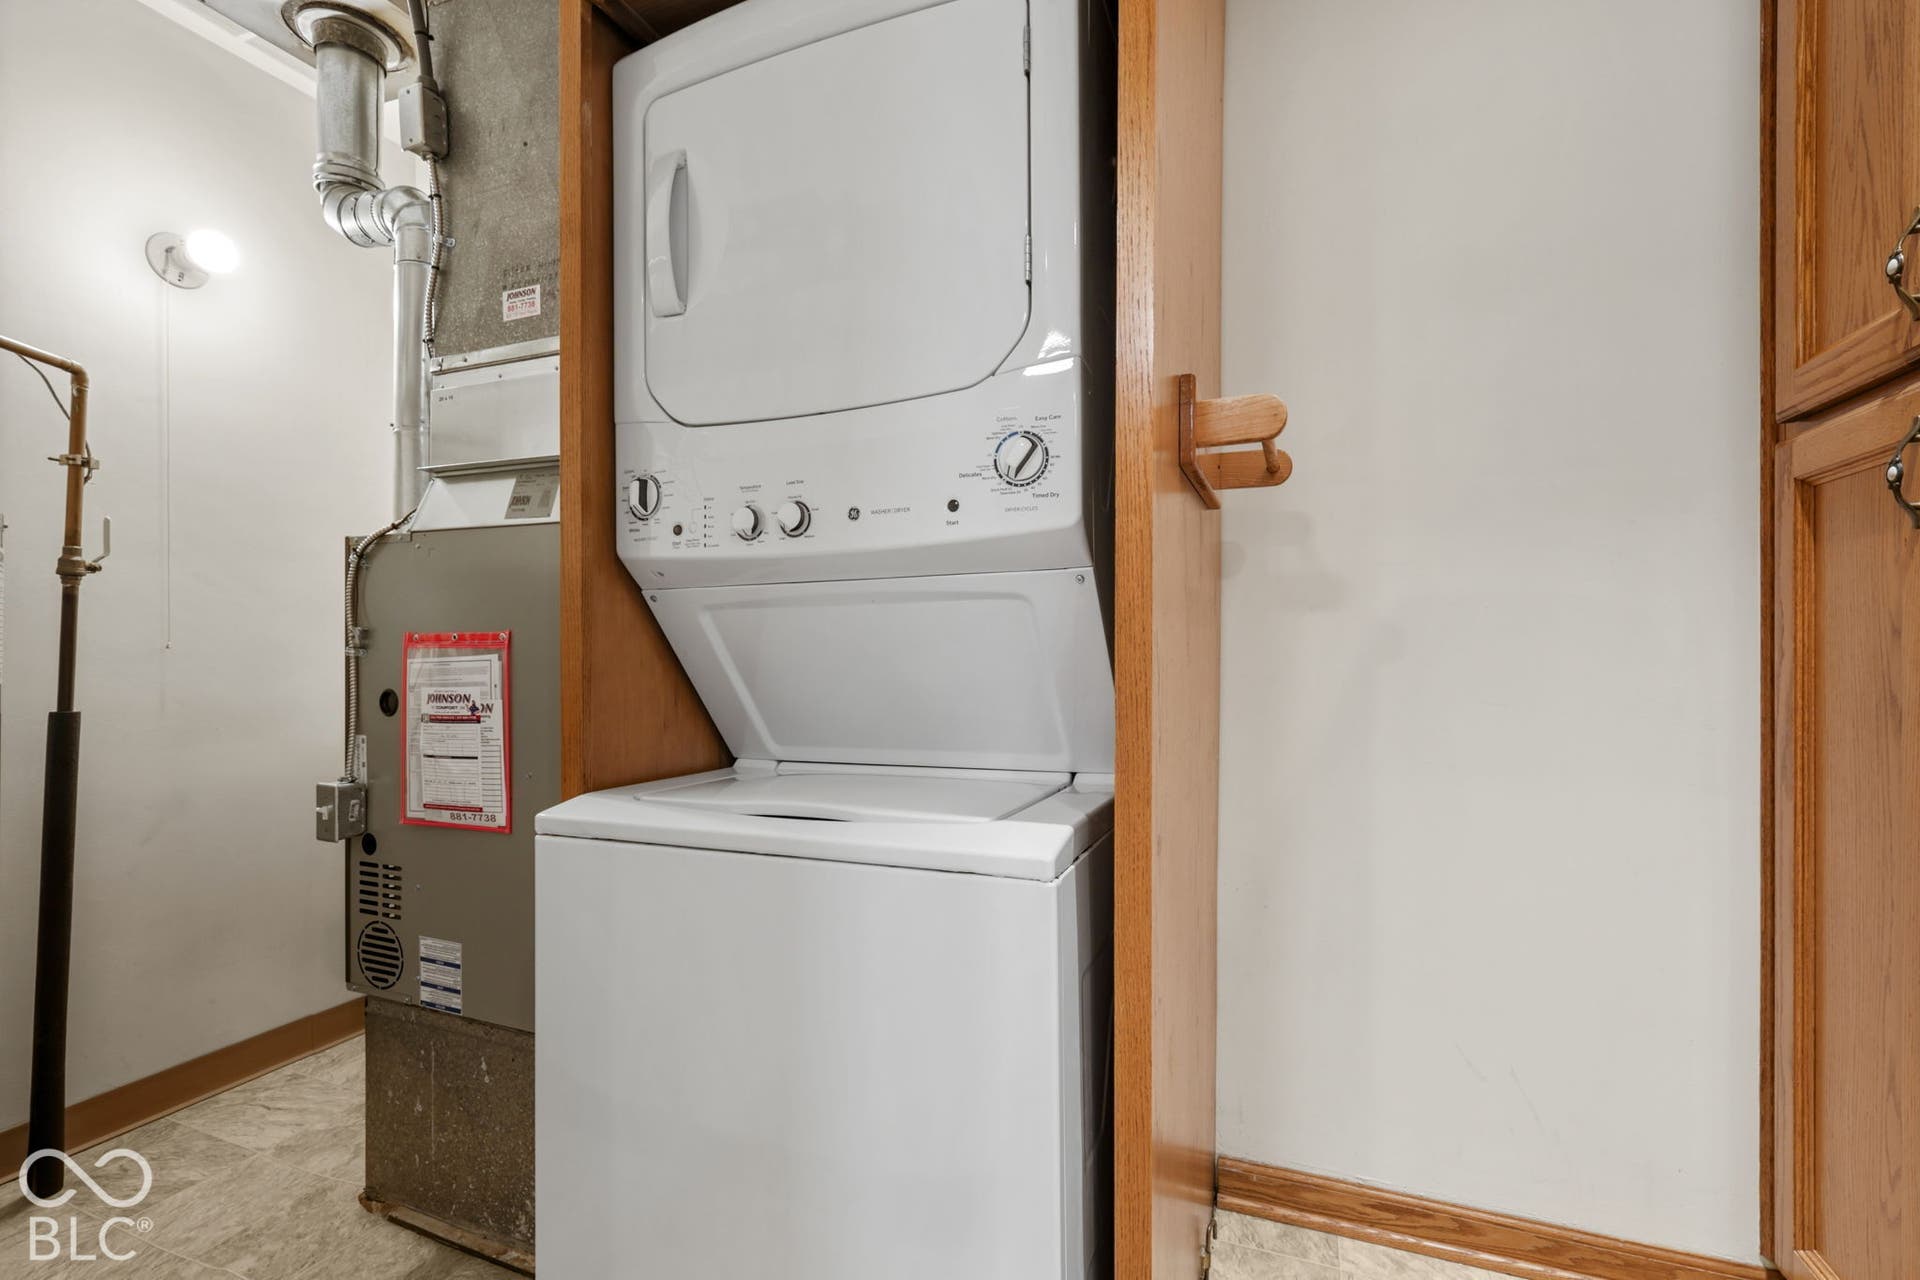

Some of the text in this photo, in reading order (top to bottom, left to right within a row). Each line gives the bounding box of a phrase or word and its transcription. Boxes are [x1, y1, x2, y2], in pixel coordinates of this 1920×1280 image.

[507, 287, 536, 302] JOHNSON
[507, 301, 535, 312] 881-7738
[1050, 491, 1060, 499] Dry
[426, 693, 471, 704] JOHNSON
[449, 812, 497, 822] 881-7738
